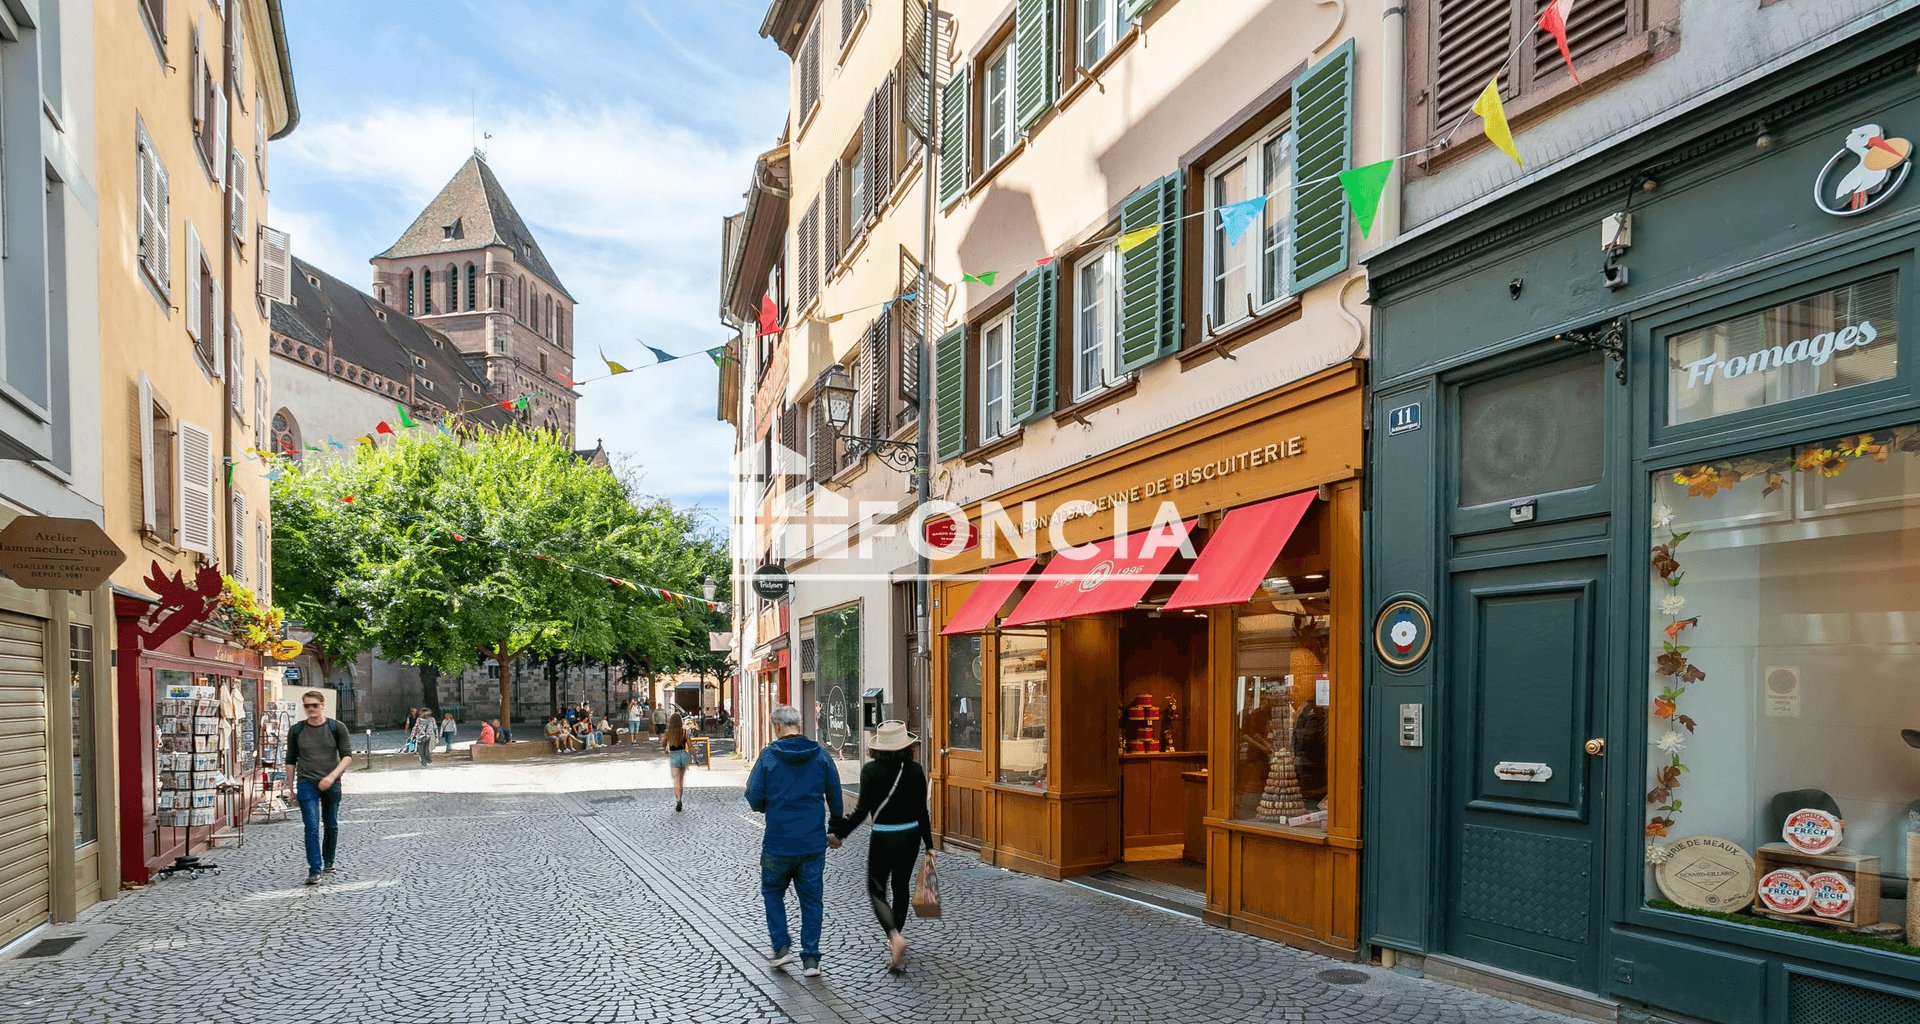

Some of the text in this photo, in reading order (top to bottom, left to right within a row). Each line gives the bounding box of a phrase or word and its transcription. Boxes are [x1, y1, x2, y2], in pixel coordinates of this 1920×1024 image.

[1683, 320, 1877, 389] Fromages
[1397, 407, 1411, 425] 11
[1005, 435, 1302, 538] MAISON ALSACIENNE DE BISCUITERIE
[34, 532, 78, 543] Atelier
[79, 546, 117, 557] Sipion
[12, 562, 101, 572] JOAILLIER CRÉATEUR
[1115, 565, 1145, 577] 1996
[31, 571, 61, 579] DEPUIS
[1793, 828, 1828, 836] FRECH
[1666, 839, 1740, 859] BRIE DE MEAUX
[1768, 888, 1800, 896] FRECH
